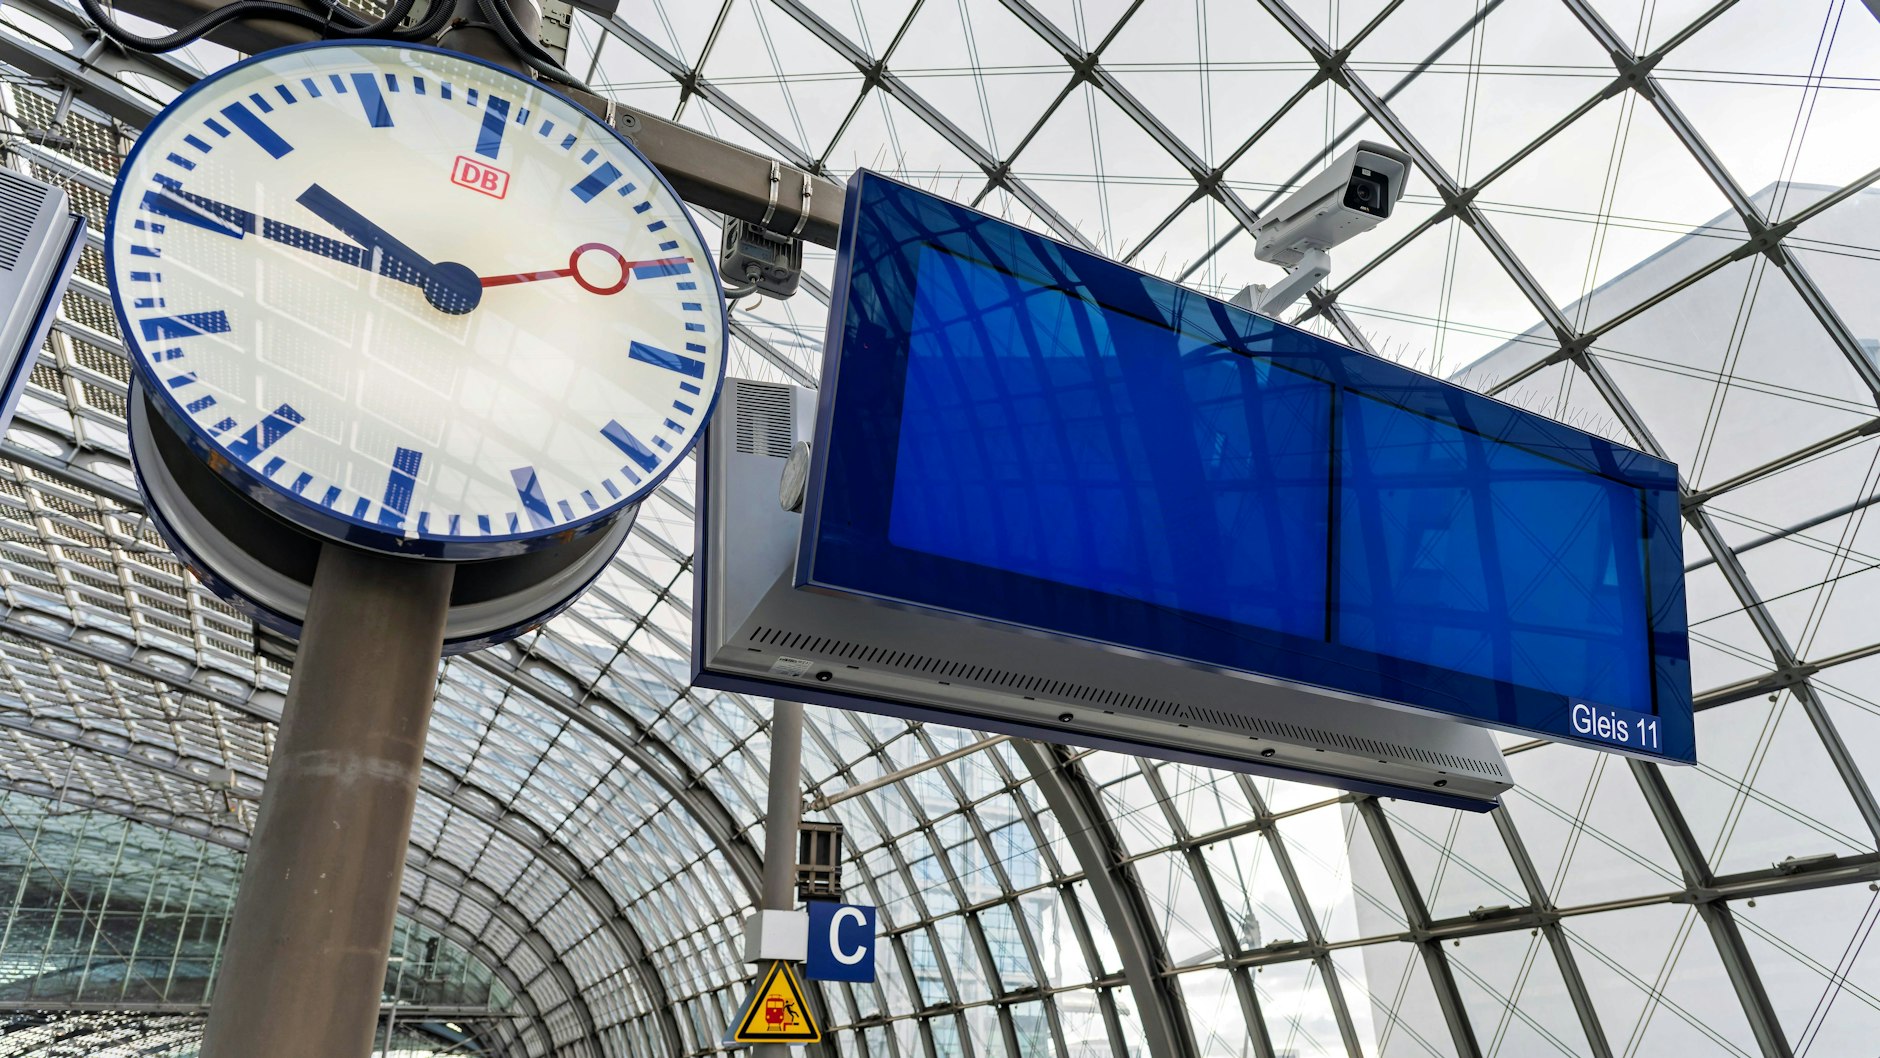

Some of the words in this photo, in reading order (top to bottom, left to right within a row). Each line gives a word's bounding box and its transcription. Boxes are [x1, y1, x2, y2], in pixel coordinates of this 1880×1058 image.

[461, 162, 499, 191] DB
[1572, 703, 1629, 742] Gleis
[1636, 717, 1658, 749] 11
[829, 906, 868, 965] C
